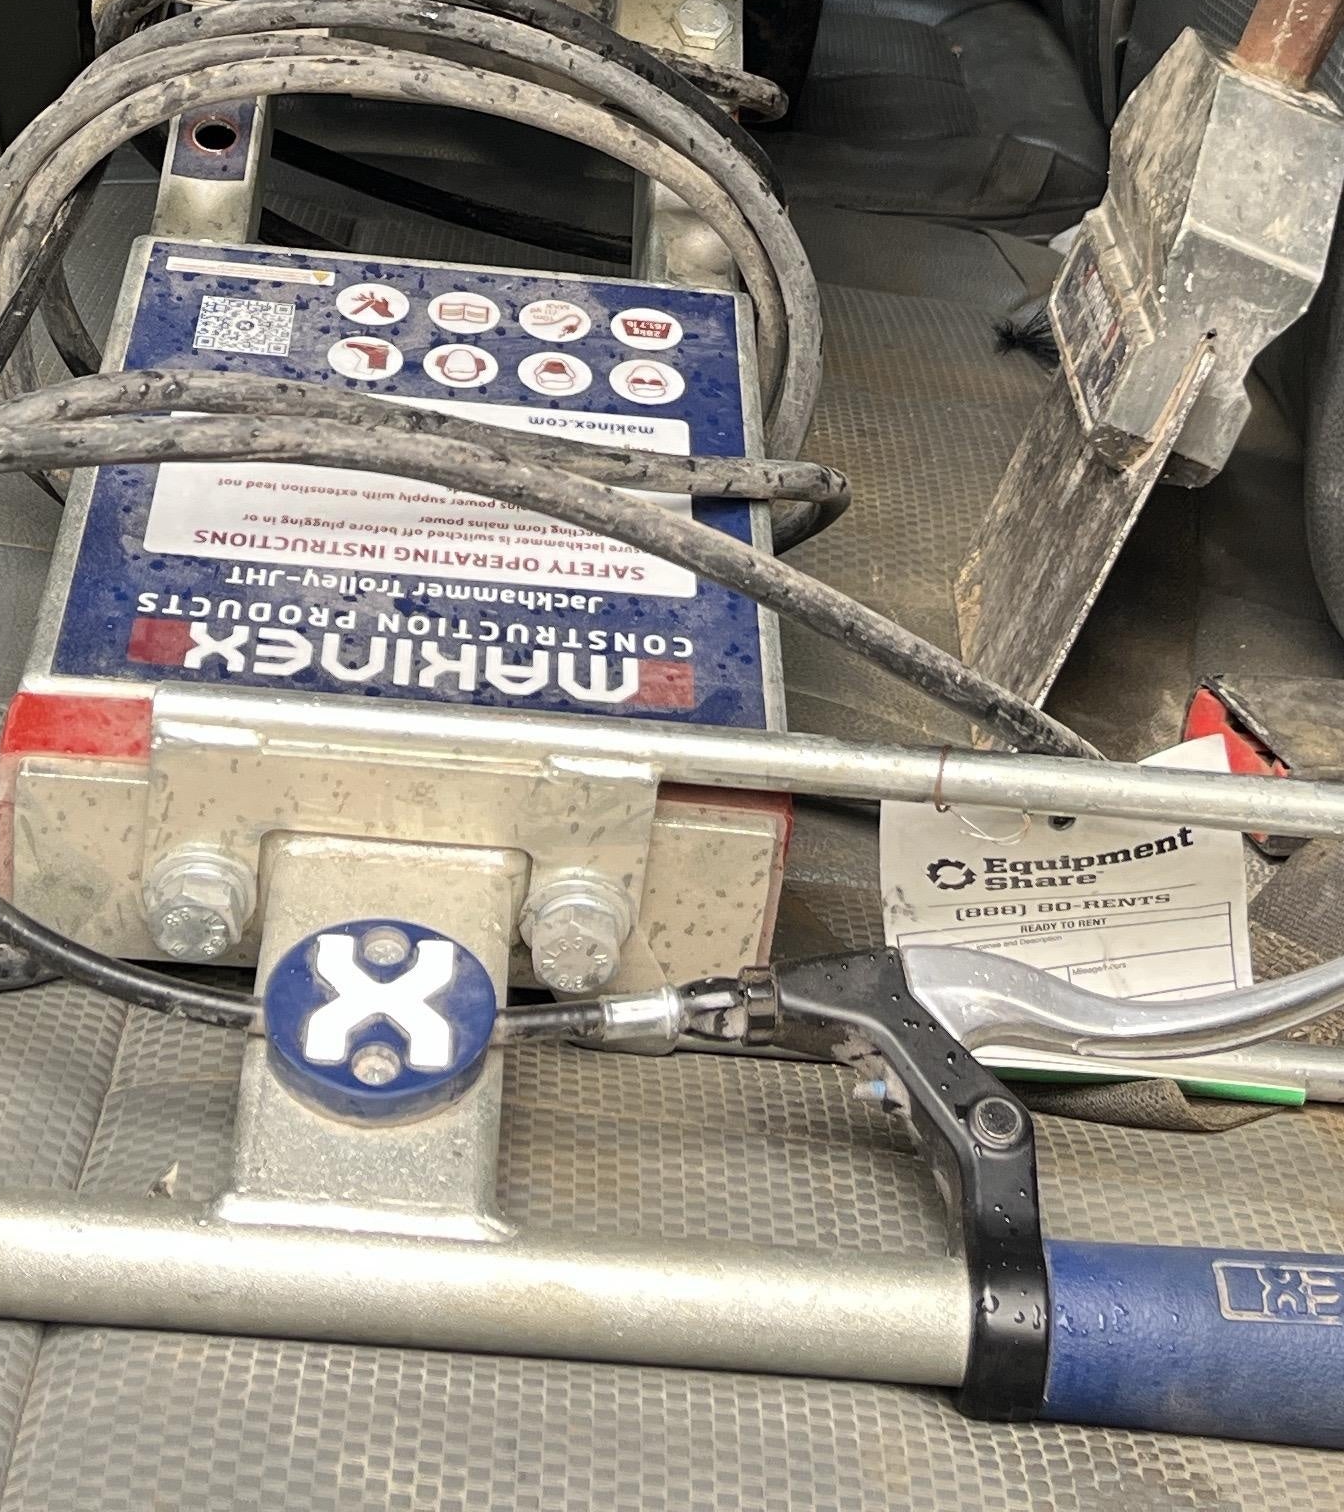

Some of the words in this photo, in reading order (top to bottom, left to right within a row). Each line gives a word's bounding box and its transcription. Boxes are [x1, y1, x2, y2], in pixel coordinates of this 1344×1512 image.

[528, 415, 655, 435] makinex.com
[217, 477, 242, 487] not
[245, 480, 278, 491] lead
[361, 489, 395, 501] with
[398, 491, 447, 505] supply
[449, 494, 497, 510] power
[242, 512, 258, 522] or
[262, 513, 277, 525] in
[280, 515, 346, 531] plugging
[417, 514, 465, 527] power
[467, 518, 510, 530] mains
[347, 522, 397, 536] before
[399, 524, 423, 537] off
[426, 529, 496, 545] switched
[513, 523, 548, 535] form
[193, 529, 385, 560] INSTRUCTIONS
[498, 535, 511, 546] is
[514, 537, 605, 554] jackhammer
[393, 546, 540, 572] OPERATING
[547, 559, 646, 581] SAFETY
[224, 565, 405, 598] Trolley-JHT
[413, 579, 604, 614] Jackhammer
[136, 592, 356, 630] PRODUCTS
[377, 612, 693, 658] CONSTRUCTION
[183, 620, 640, 704] MAKINEX
[982, 825, 1195, 877] Equipment
[984, 870, 1098, 891] Share
[955, 903, 1027, 922] (888)
[1020, 921, 1058, 934] READY
[1060, 919, 1077, 930] TO
[1078, 916, 1108, 928] RENT
